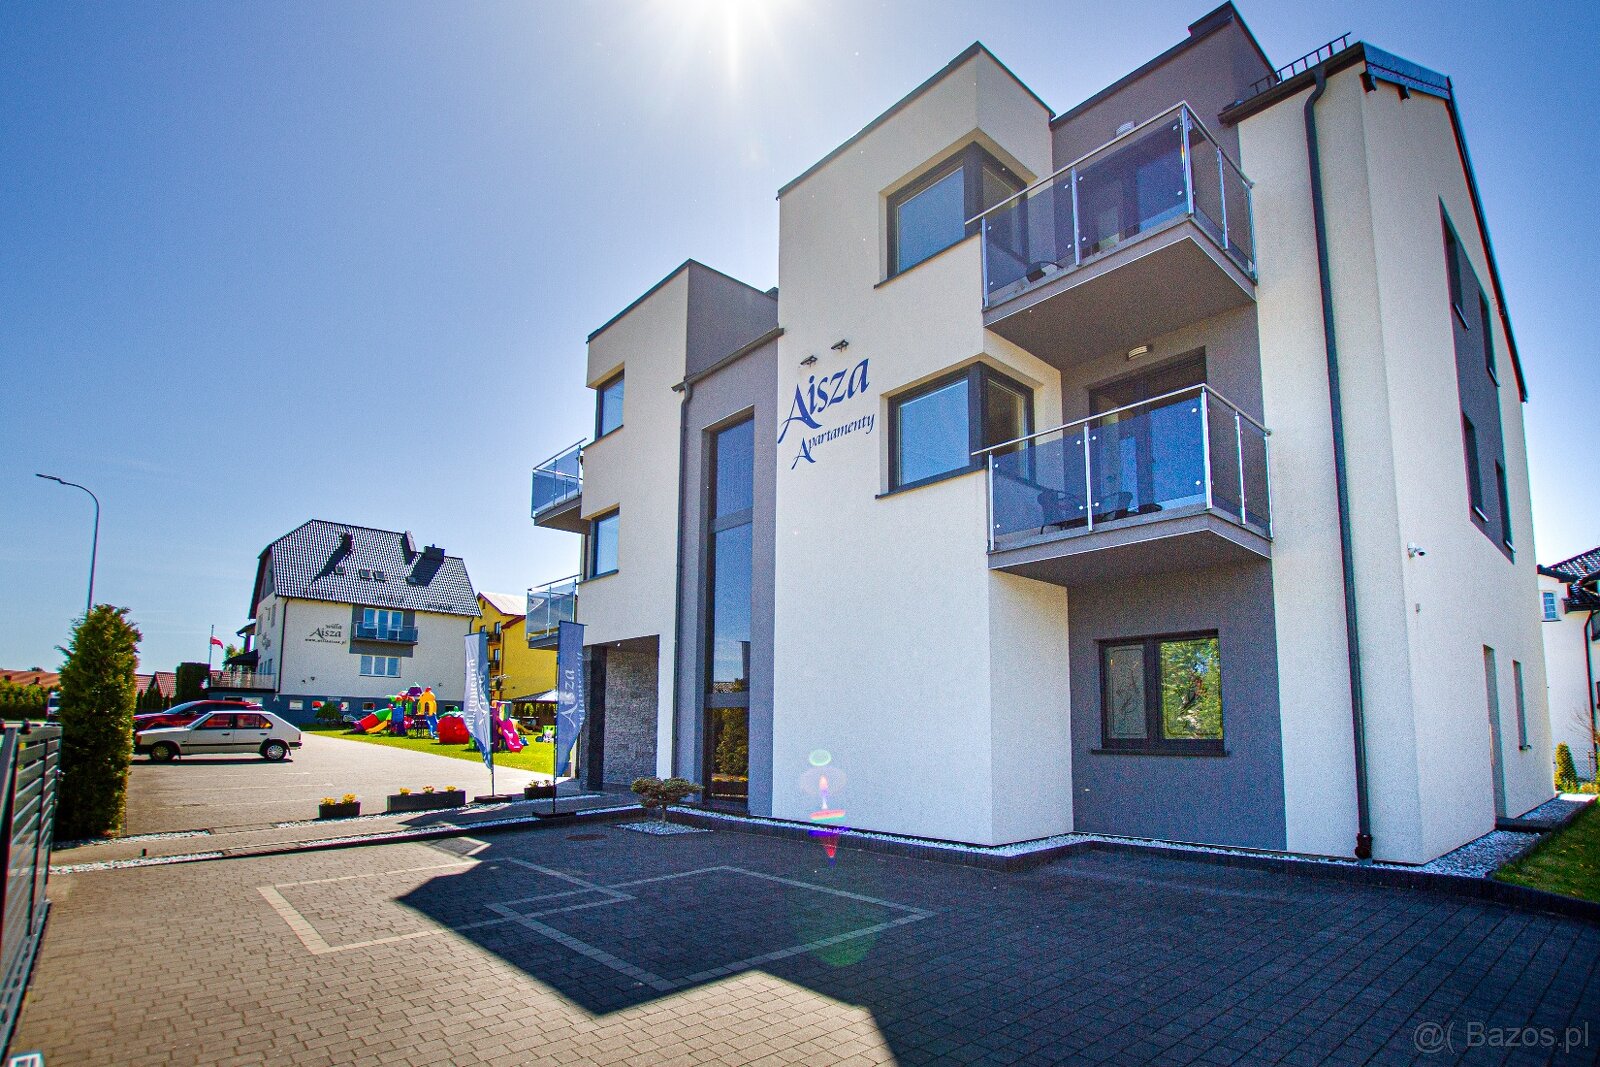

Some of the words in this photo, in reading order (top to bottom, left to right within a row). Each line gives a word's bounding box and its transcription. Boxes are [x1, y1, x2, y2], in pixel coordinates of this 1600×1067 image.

[777, 358, 870, 444] Aisza
[791, 413, 875, 470] Apartamenty
[309, 627, 341, 639] Aisza
